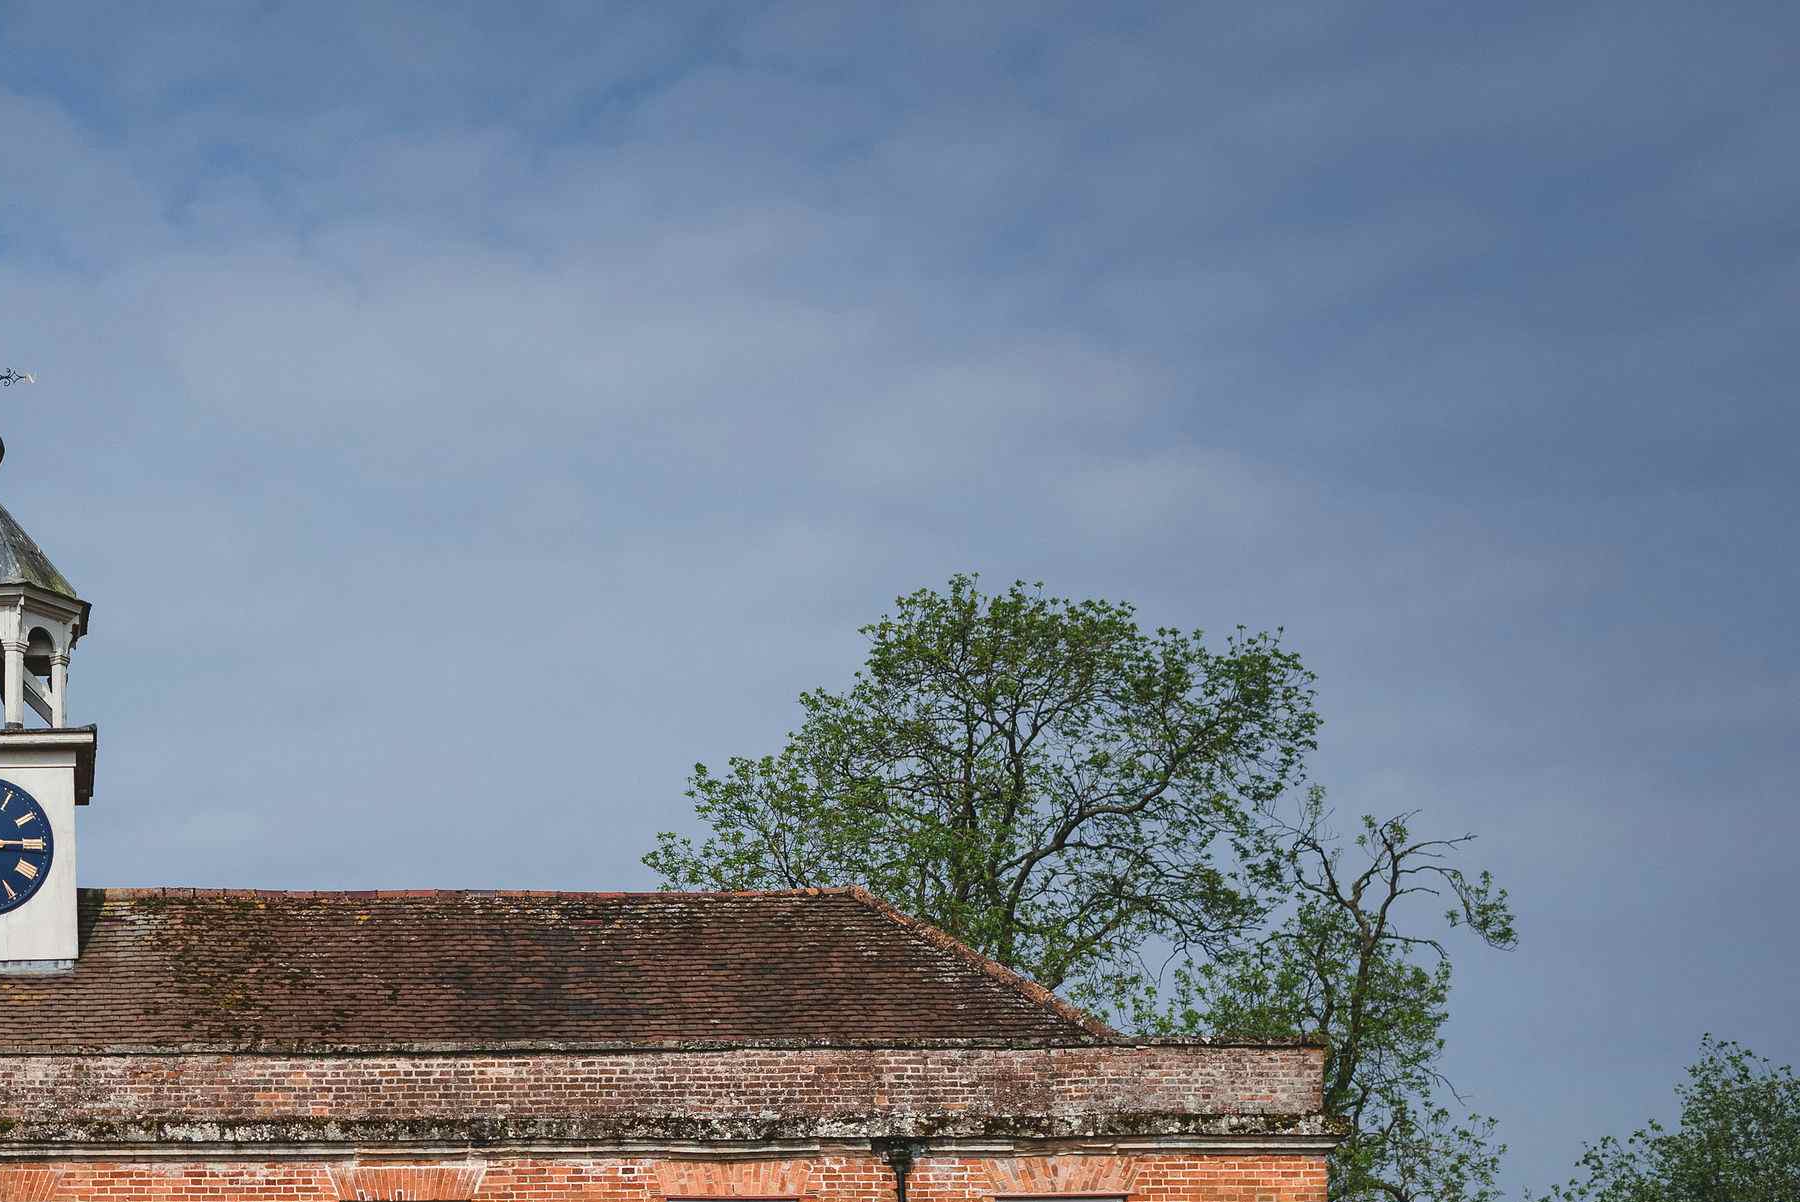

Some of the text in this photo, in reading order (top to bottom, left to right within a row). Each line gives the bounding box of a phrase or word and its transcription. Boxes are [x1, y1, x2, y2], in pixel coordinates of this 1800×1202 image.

[1, 792, 13, 811] I
[15, 811, 36, 828] II
[22, 836, 44, 851] III
